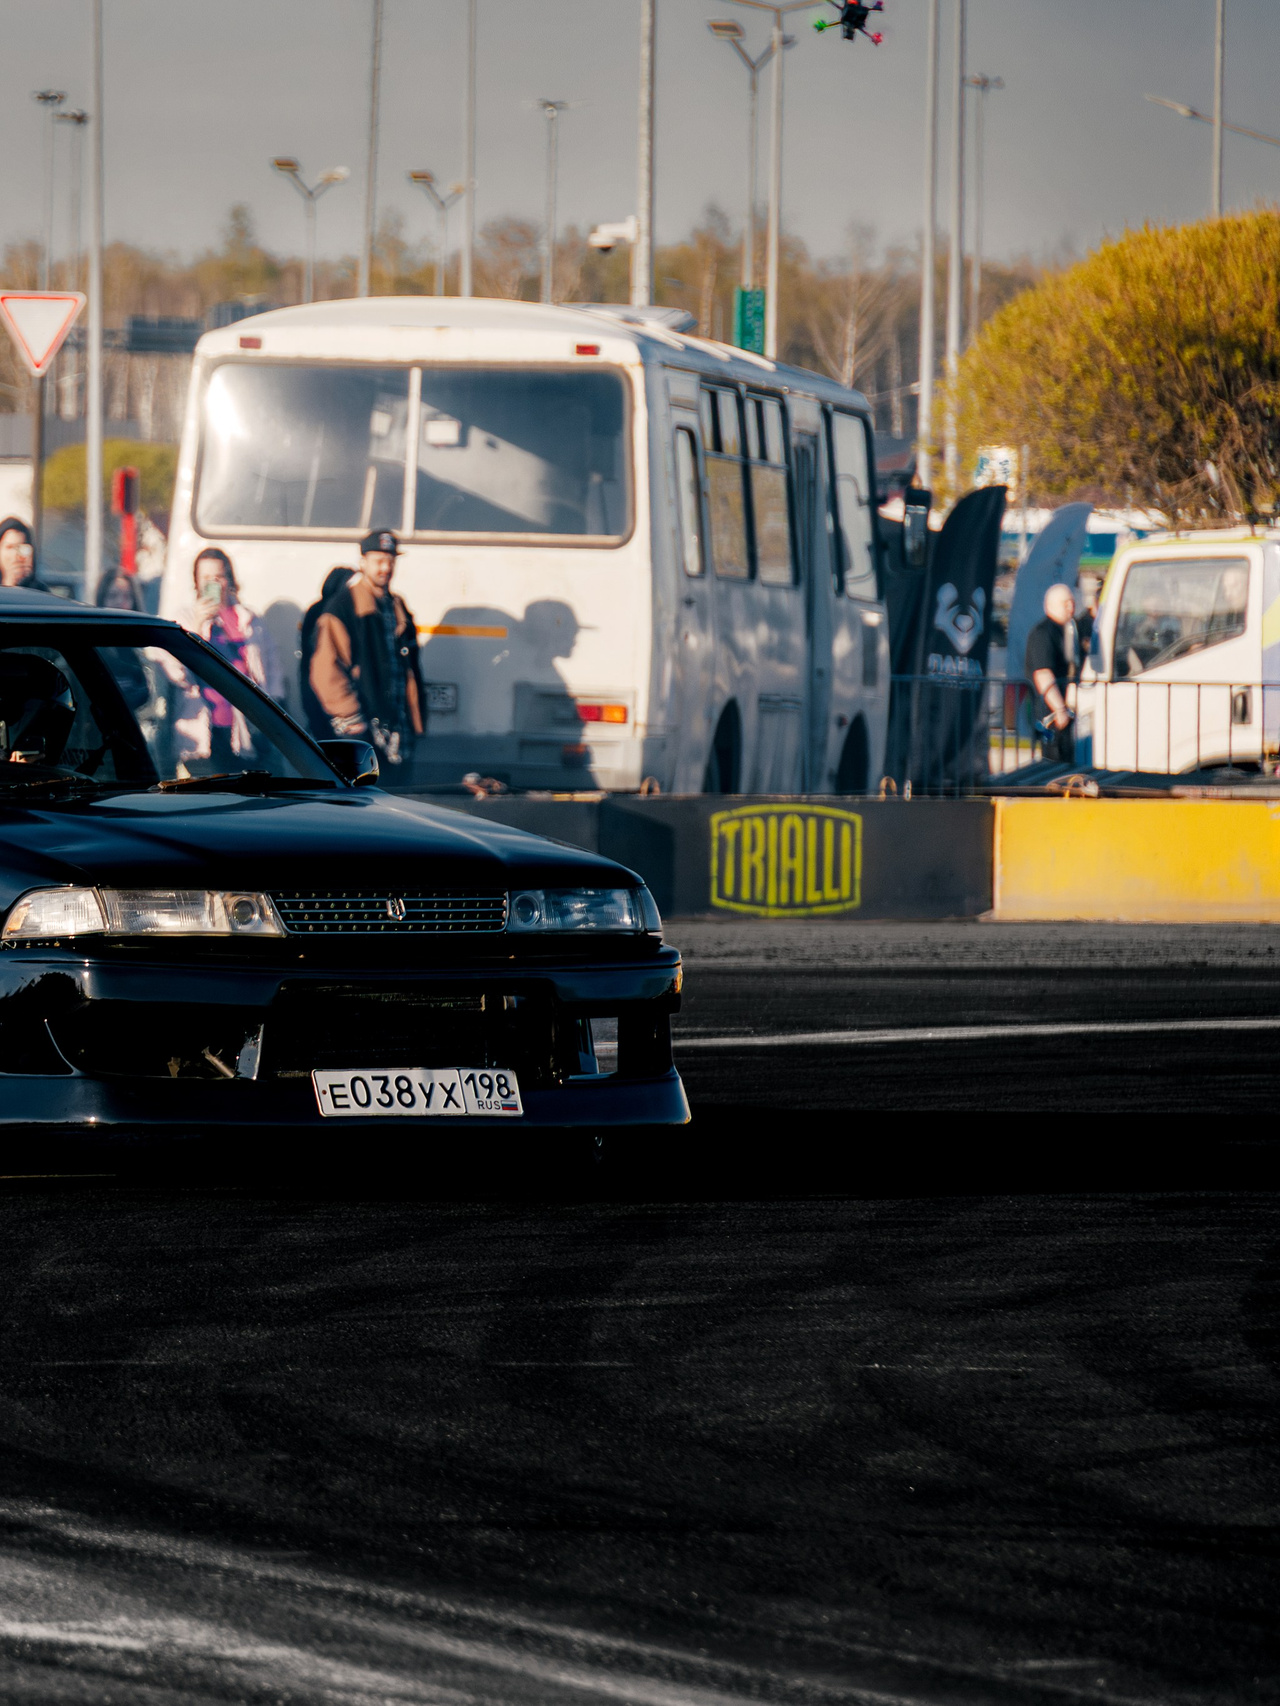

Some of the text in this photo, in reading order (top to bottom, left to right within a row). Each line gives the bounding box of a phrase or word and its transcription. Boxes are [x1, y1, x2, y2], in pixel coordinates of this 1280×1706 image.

[720, 813, 851, 906] TRIALLI
[464, 1073, 511, 1099] 198
[477, 1100, 501, 1111] RUS
